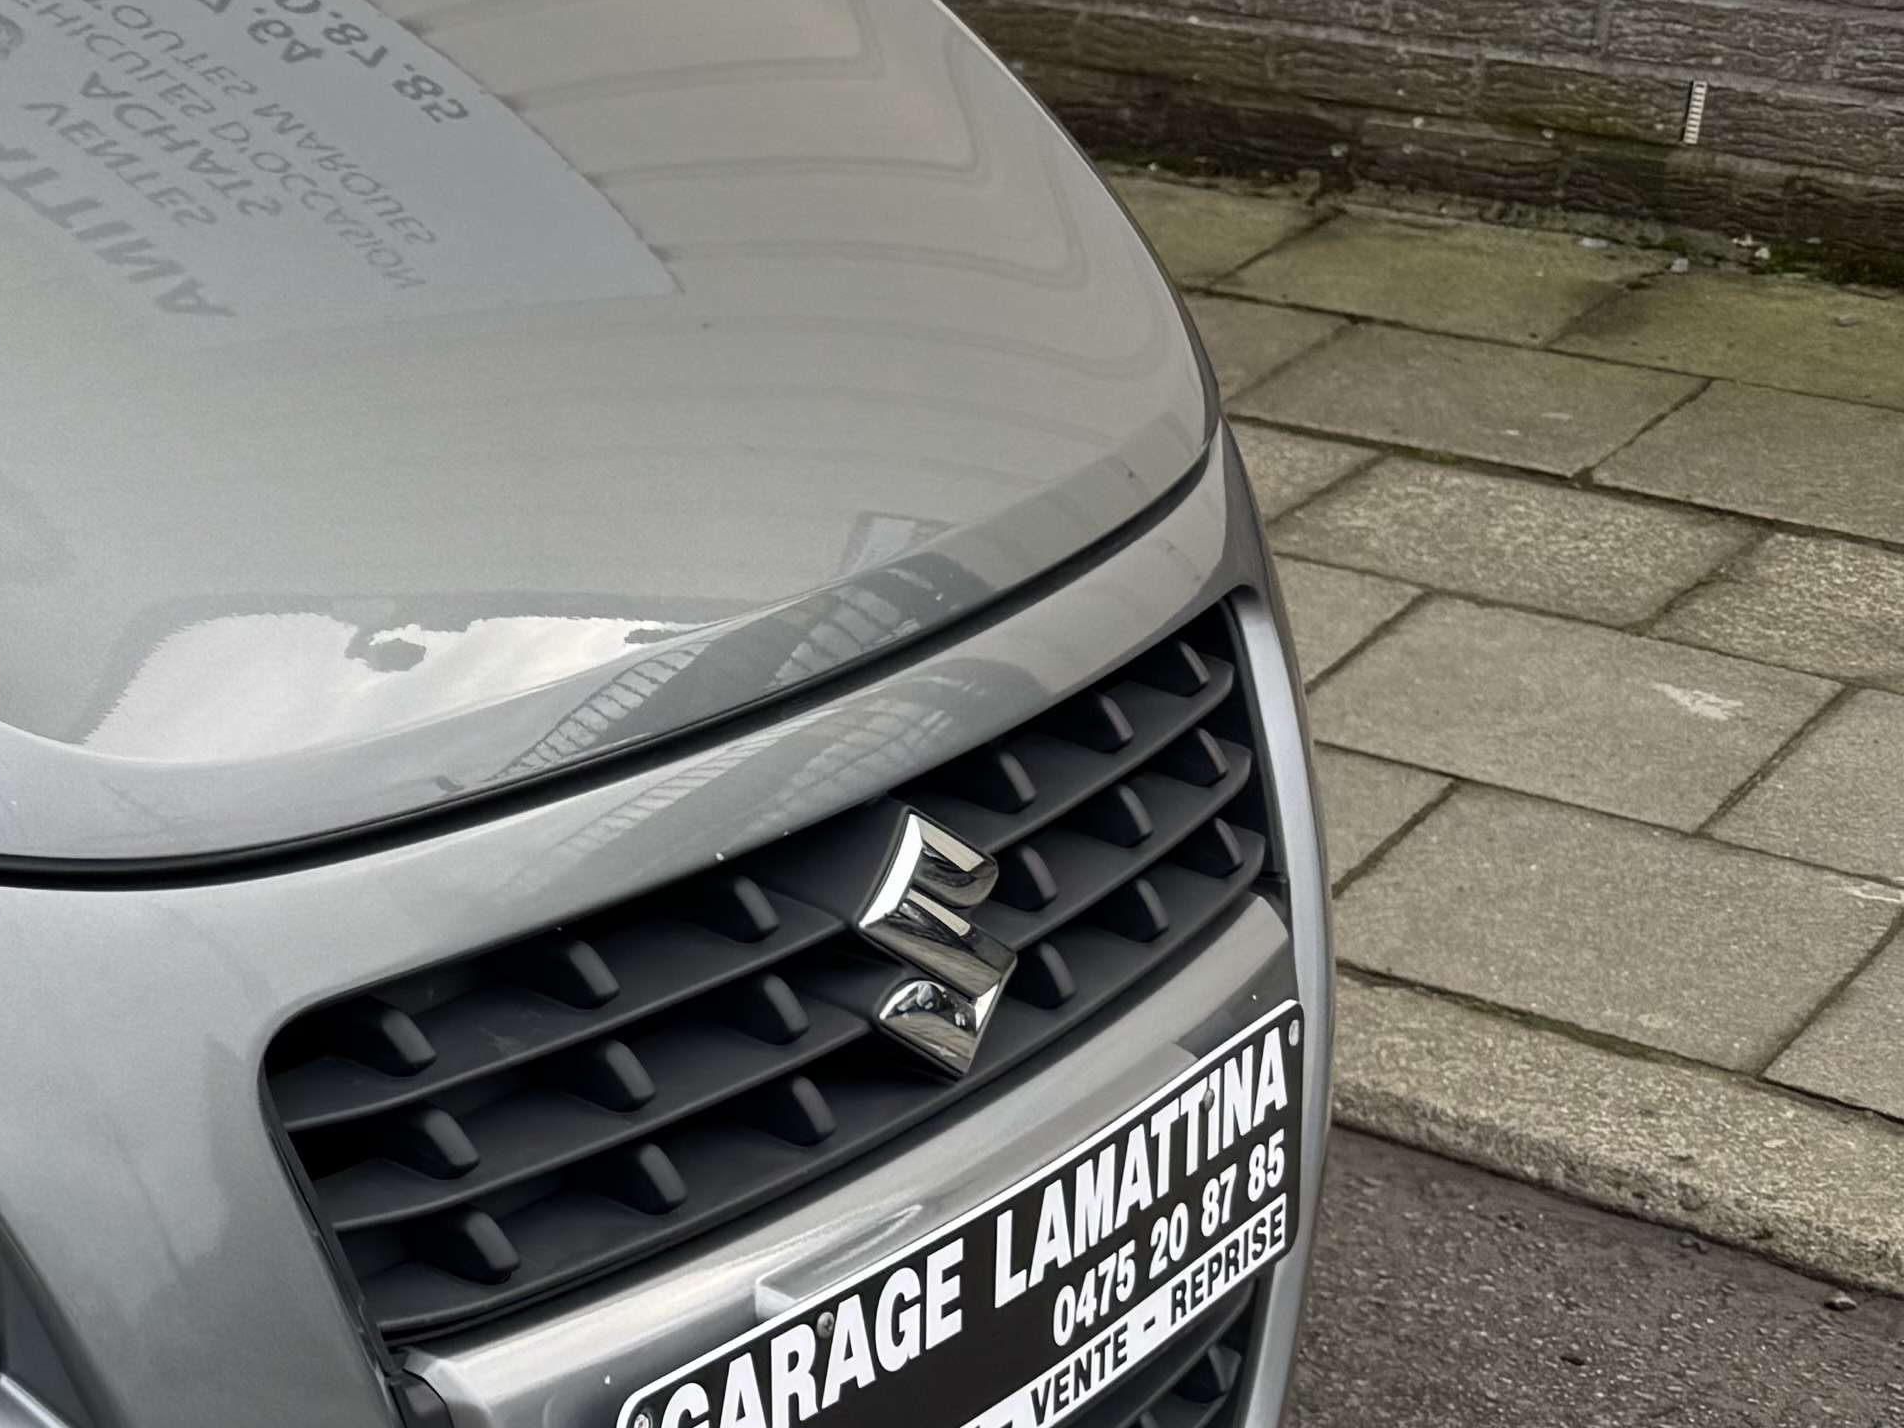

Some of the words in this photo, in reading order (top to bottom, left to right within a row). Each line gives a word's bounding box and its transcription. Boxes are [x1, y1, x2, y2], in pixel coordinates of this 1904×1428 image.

[994, 1025, 1288, 1309] LAMATTINA
[1052, 1239, 1136, 1347] 0475
[1149, 1201, 1189, 1280] 20
[1200, 1163, 1238, 1238] 87
[1247, 1128, 1285, 1203] 85
[1030, 1321, 1129, 1427] VENTE
[1170, 1204, 1285, 1328] REPRISE
